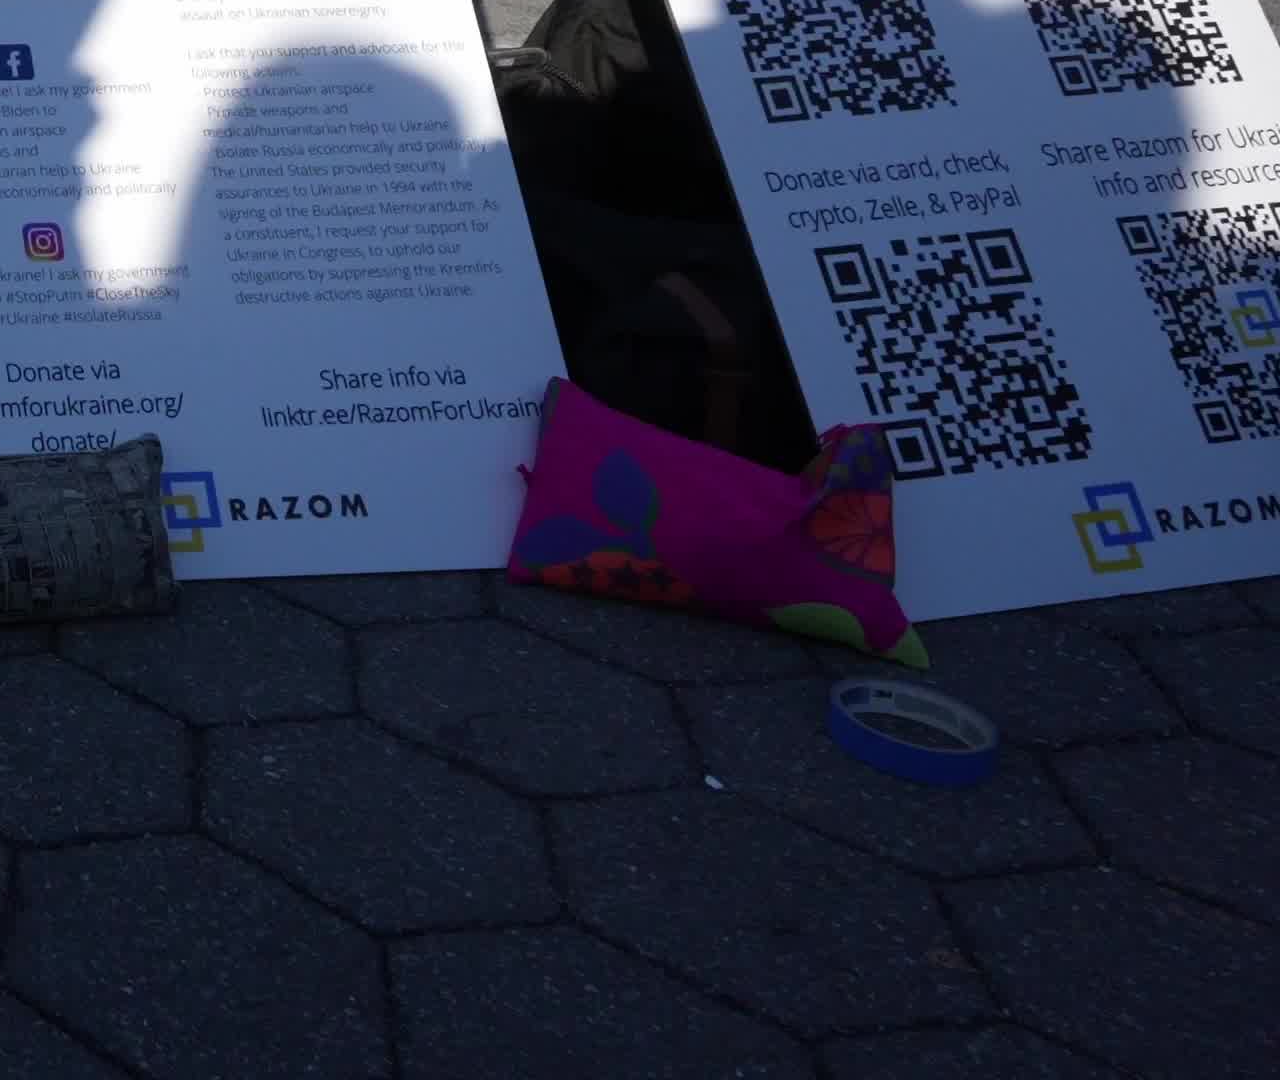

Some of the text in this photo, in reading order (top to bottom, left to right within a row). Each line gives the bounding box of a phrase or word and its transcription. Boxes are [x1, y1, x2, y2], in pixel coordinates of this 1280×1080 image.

[22, 83, 47, 97] ask
[46, 85, 69, 100] my
[41, 103, 57, 117] to
[11, 143, 39, 158] and
[1039, 142, 1110, 166] Share
[1111, 136, 1189, 159] Razom
[1190, 127, 1222, 152] for
[38, 163, 70, 179] help
[70, 164, 87, 176] to
[330, 159, 392, 176] provided
[762, 149, 1010, 192] Donate via card, check,
[291, 184, 310, 200] to
[362, 183, 379, 195] in
[449, 178, 473, 192] the
[1092, 170, 1139, 198] info
[1143, 166, 1187, 192] and
[284, 204, 309, 218] the
[787, 184, 1021, 232] crypto, Zelle, & PayPal
[378, 223, 411, 240] your
[412, 220, 468, 237] support
[469, 217, 489, 233] for
[282, 247, 297, 261] in
[367, 244, 384, 257] to
[384, 241, 435, 258] uphold
[56, 267, 81, 281] ask
[82, 268, 104, 283] my
[306, 267, 325, 285] by
[412, 263, 436, 277] the
[5, 359, 120, 383] Donate via
[319, 364, 466, 391] Share info via
[261, 398, 545, 426] linktr.ee/RazomForUkrain
[31, 428, 121, 454] donate/
[228, 493, 368, 520] RAZOM
